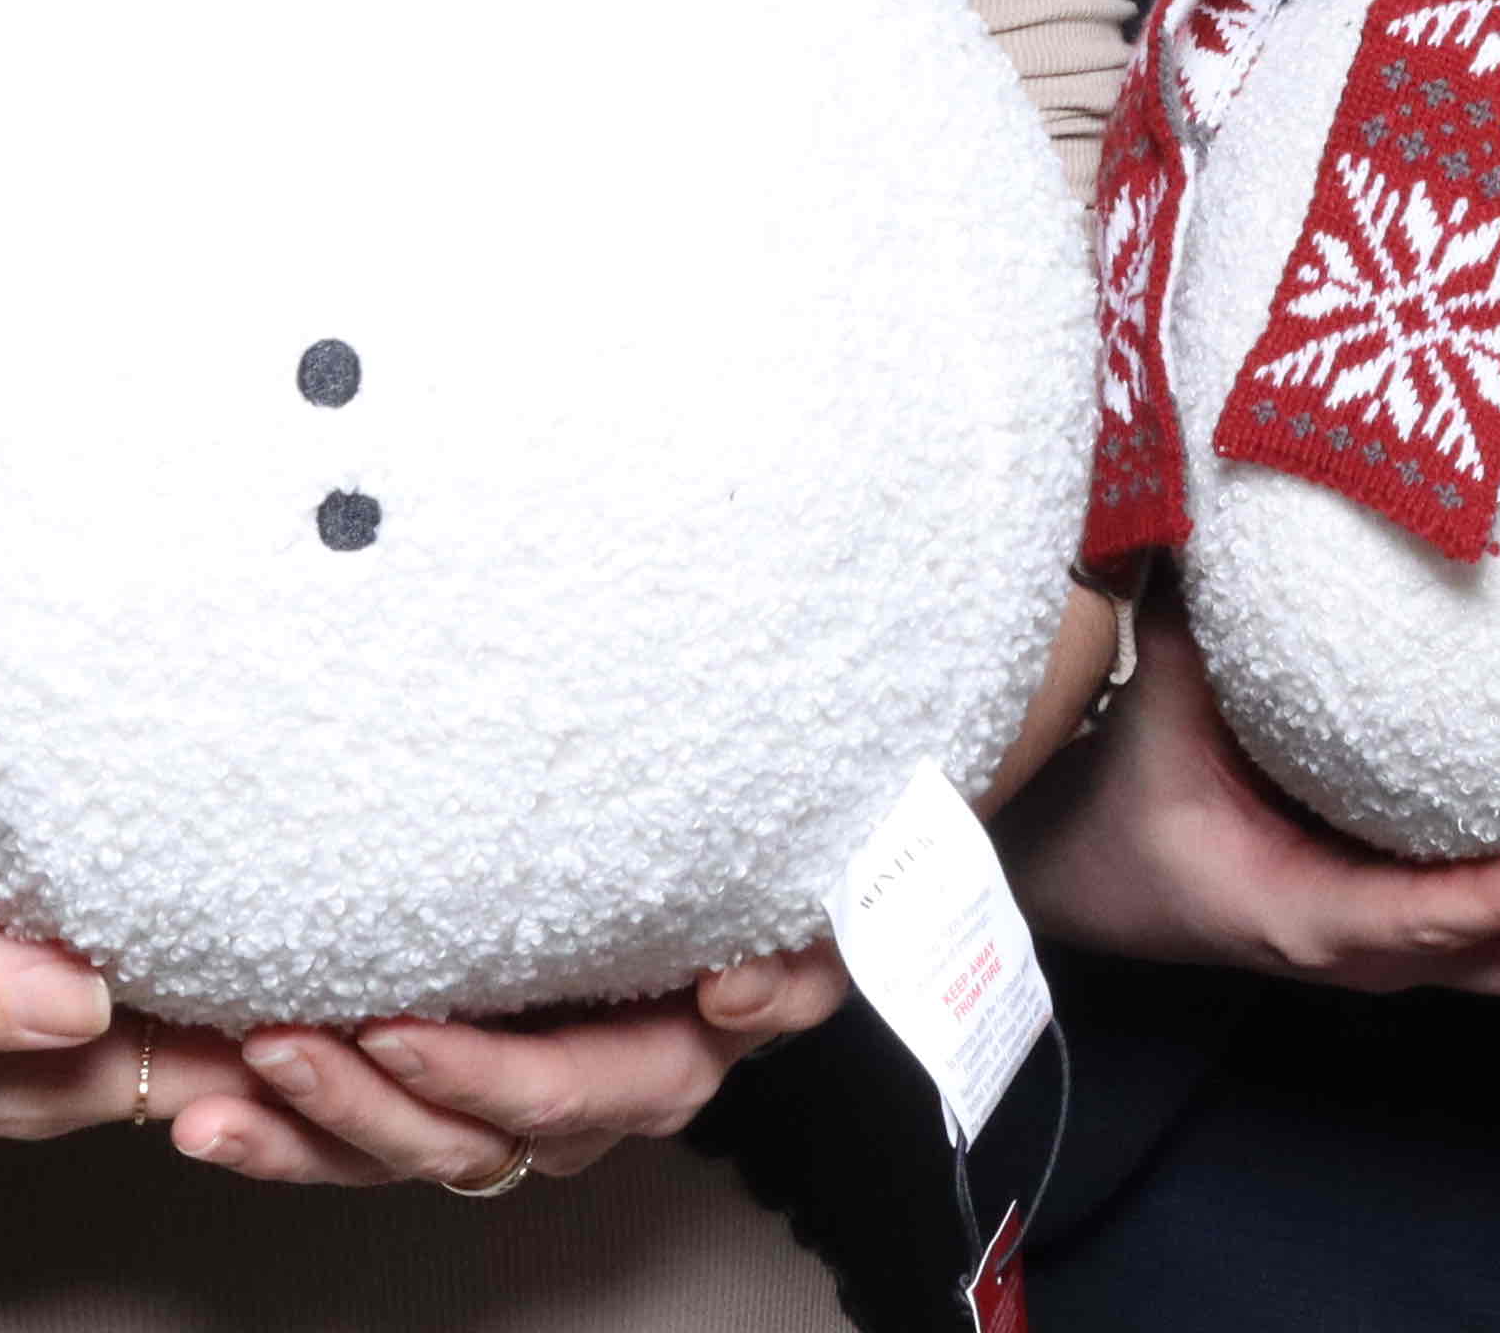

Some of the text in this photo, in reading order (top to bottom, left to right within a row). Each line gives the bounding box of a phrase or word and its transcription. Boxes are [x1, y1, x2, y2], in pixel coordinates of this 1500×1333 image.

[942, 937, 997, 1008] KEEP AWAY
[953, 955, 1003, 1025] FROM FIRE
